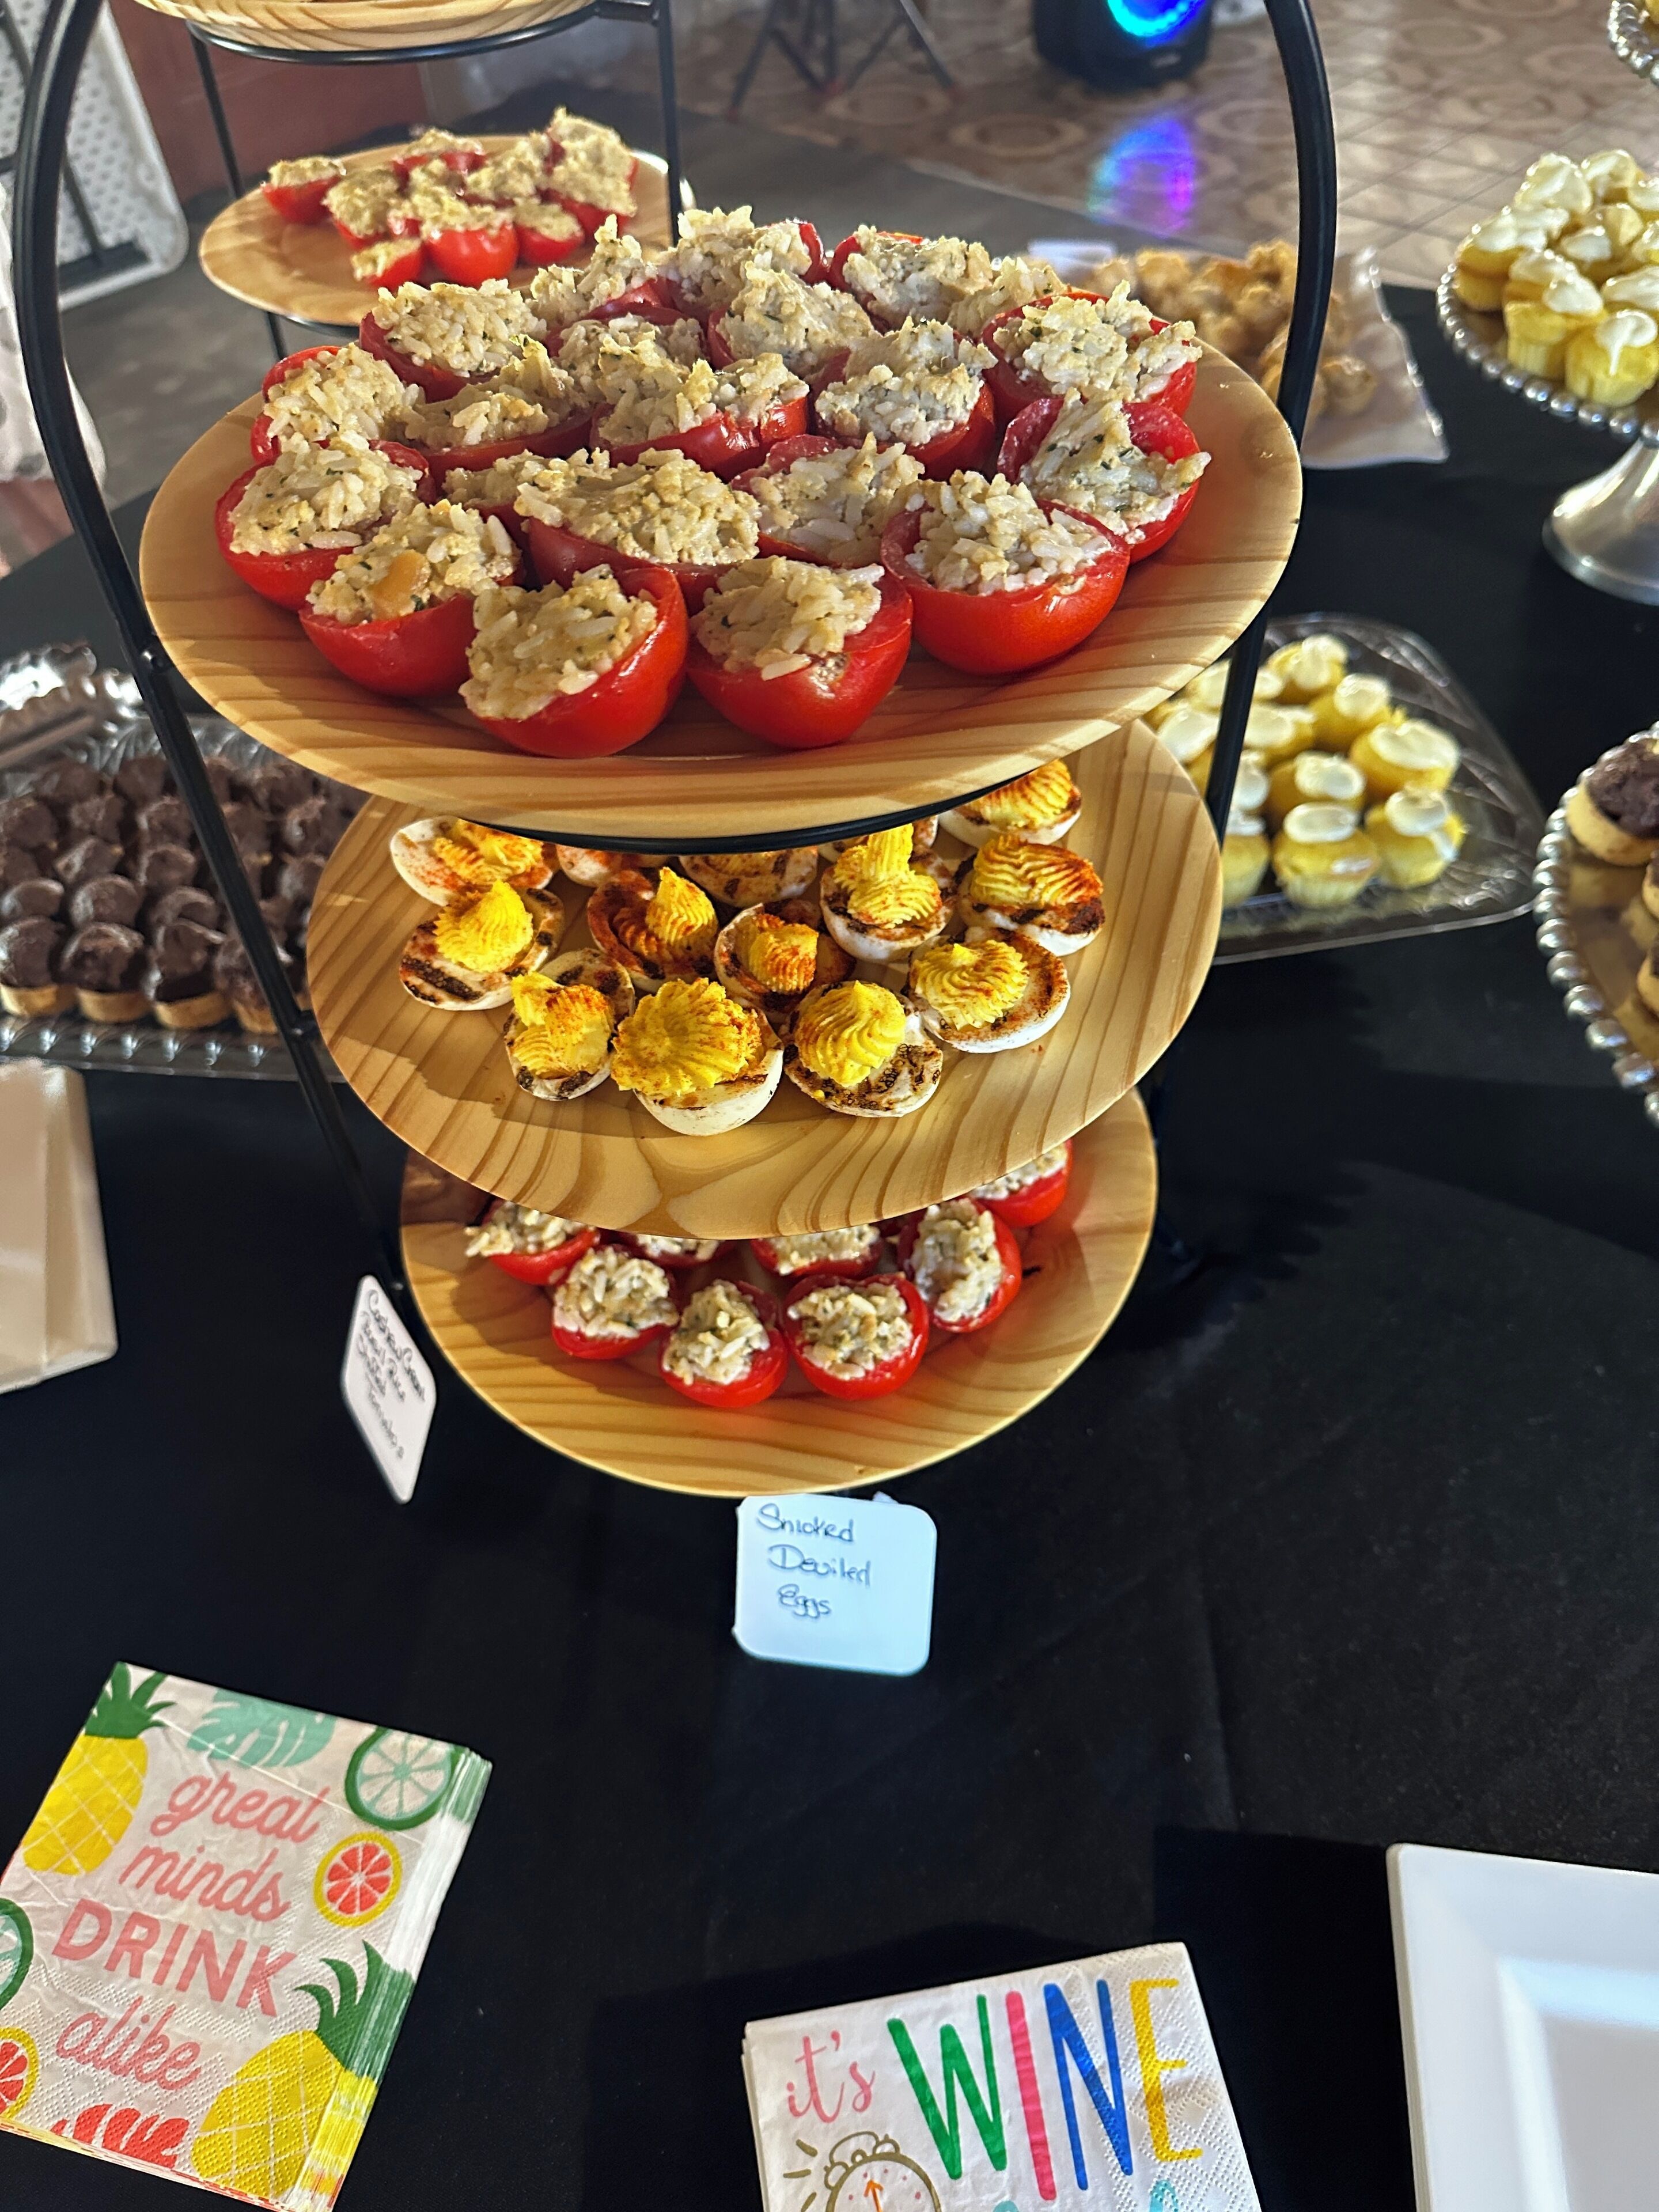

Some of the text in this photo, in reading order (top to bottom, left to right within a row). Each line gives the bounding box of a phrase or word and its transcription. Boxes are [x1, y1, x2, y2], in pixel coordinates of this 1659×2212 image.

[151, 1771, 329, 1843] great
[119, 1844, 291, 1923] minds
[52, 1897, 297, 2018] DRINK
[55, 1995, 205, 2091] alike
[786, 1979, 1203, 2201] it's WINE
